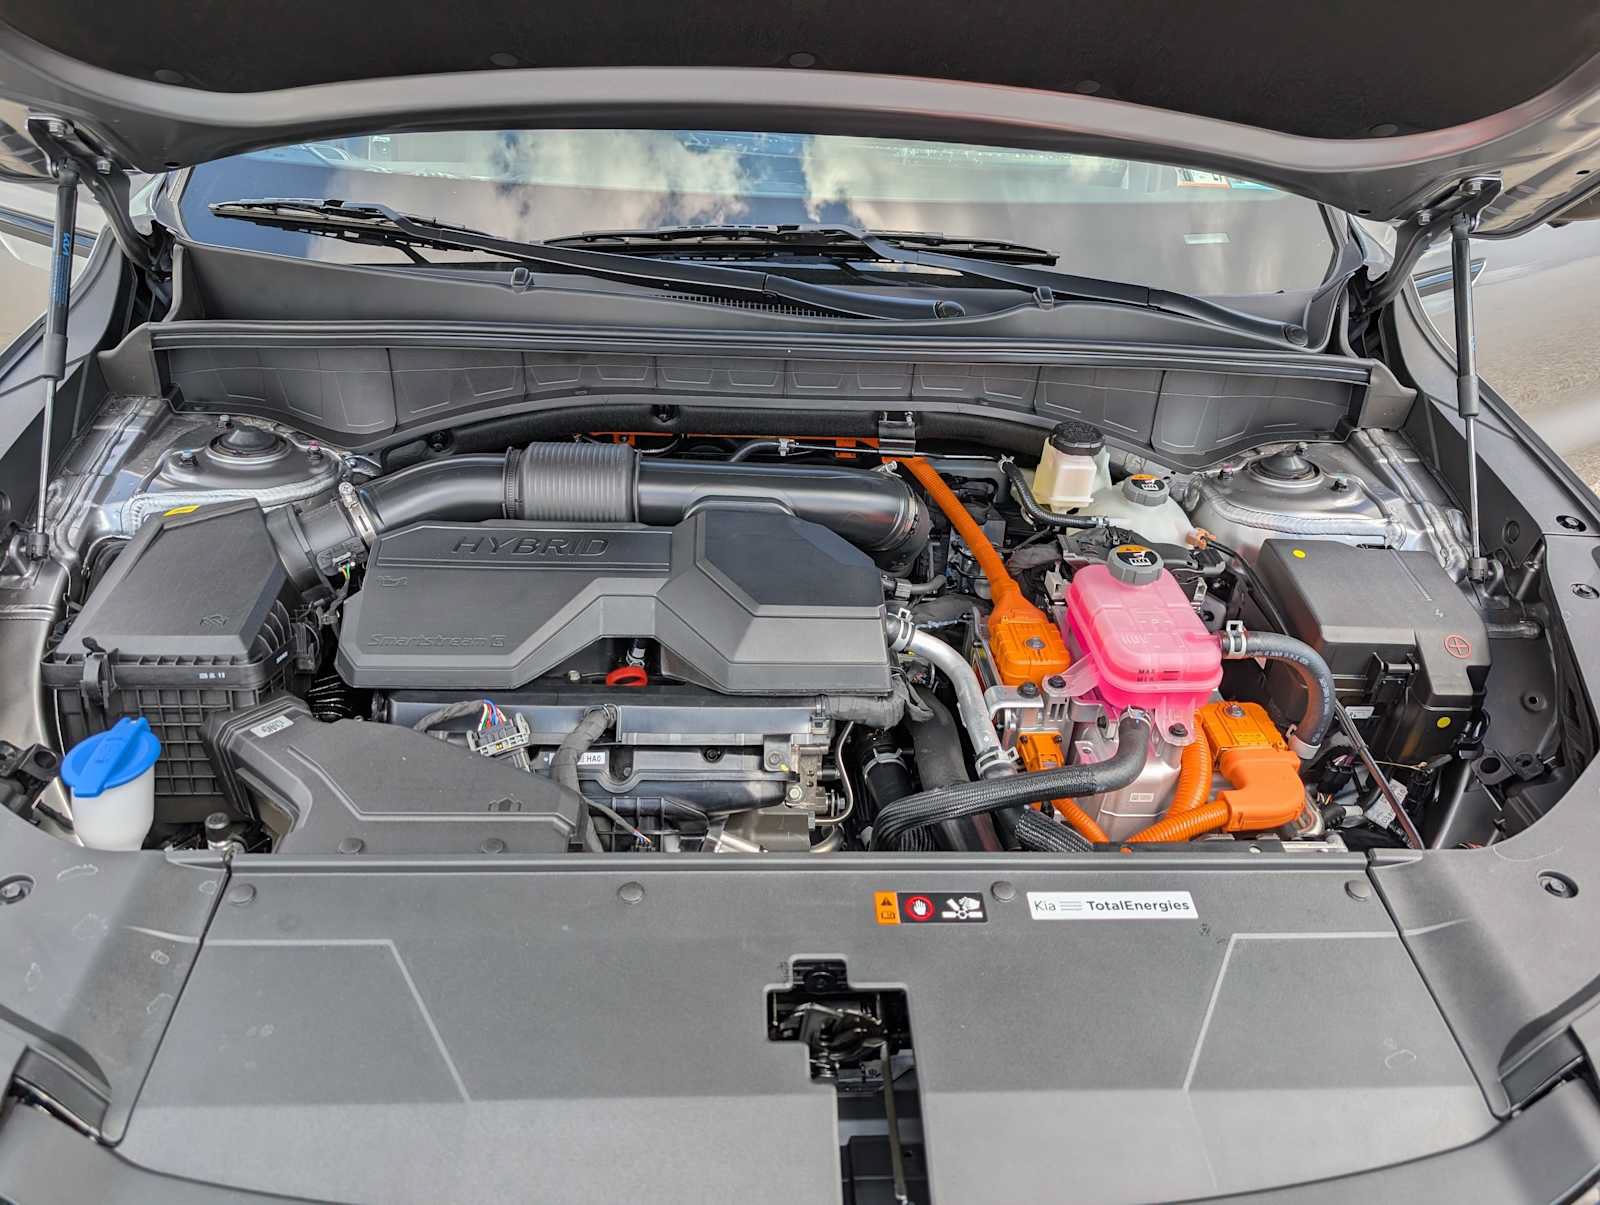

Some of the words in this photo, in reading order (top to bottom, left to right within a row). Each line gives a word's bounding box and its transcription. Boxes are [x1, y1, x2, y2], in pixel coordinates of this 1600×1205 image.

[451, 535, 609, 556] HYBRID
[367, 633, 489, 648] Smartstream
[1033, 900, 1057, 912] Kia
[1086, 899, 1190, 913] TotalEnergies
